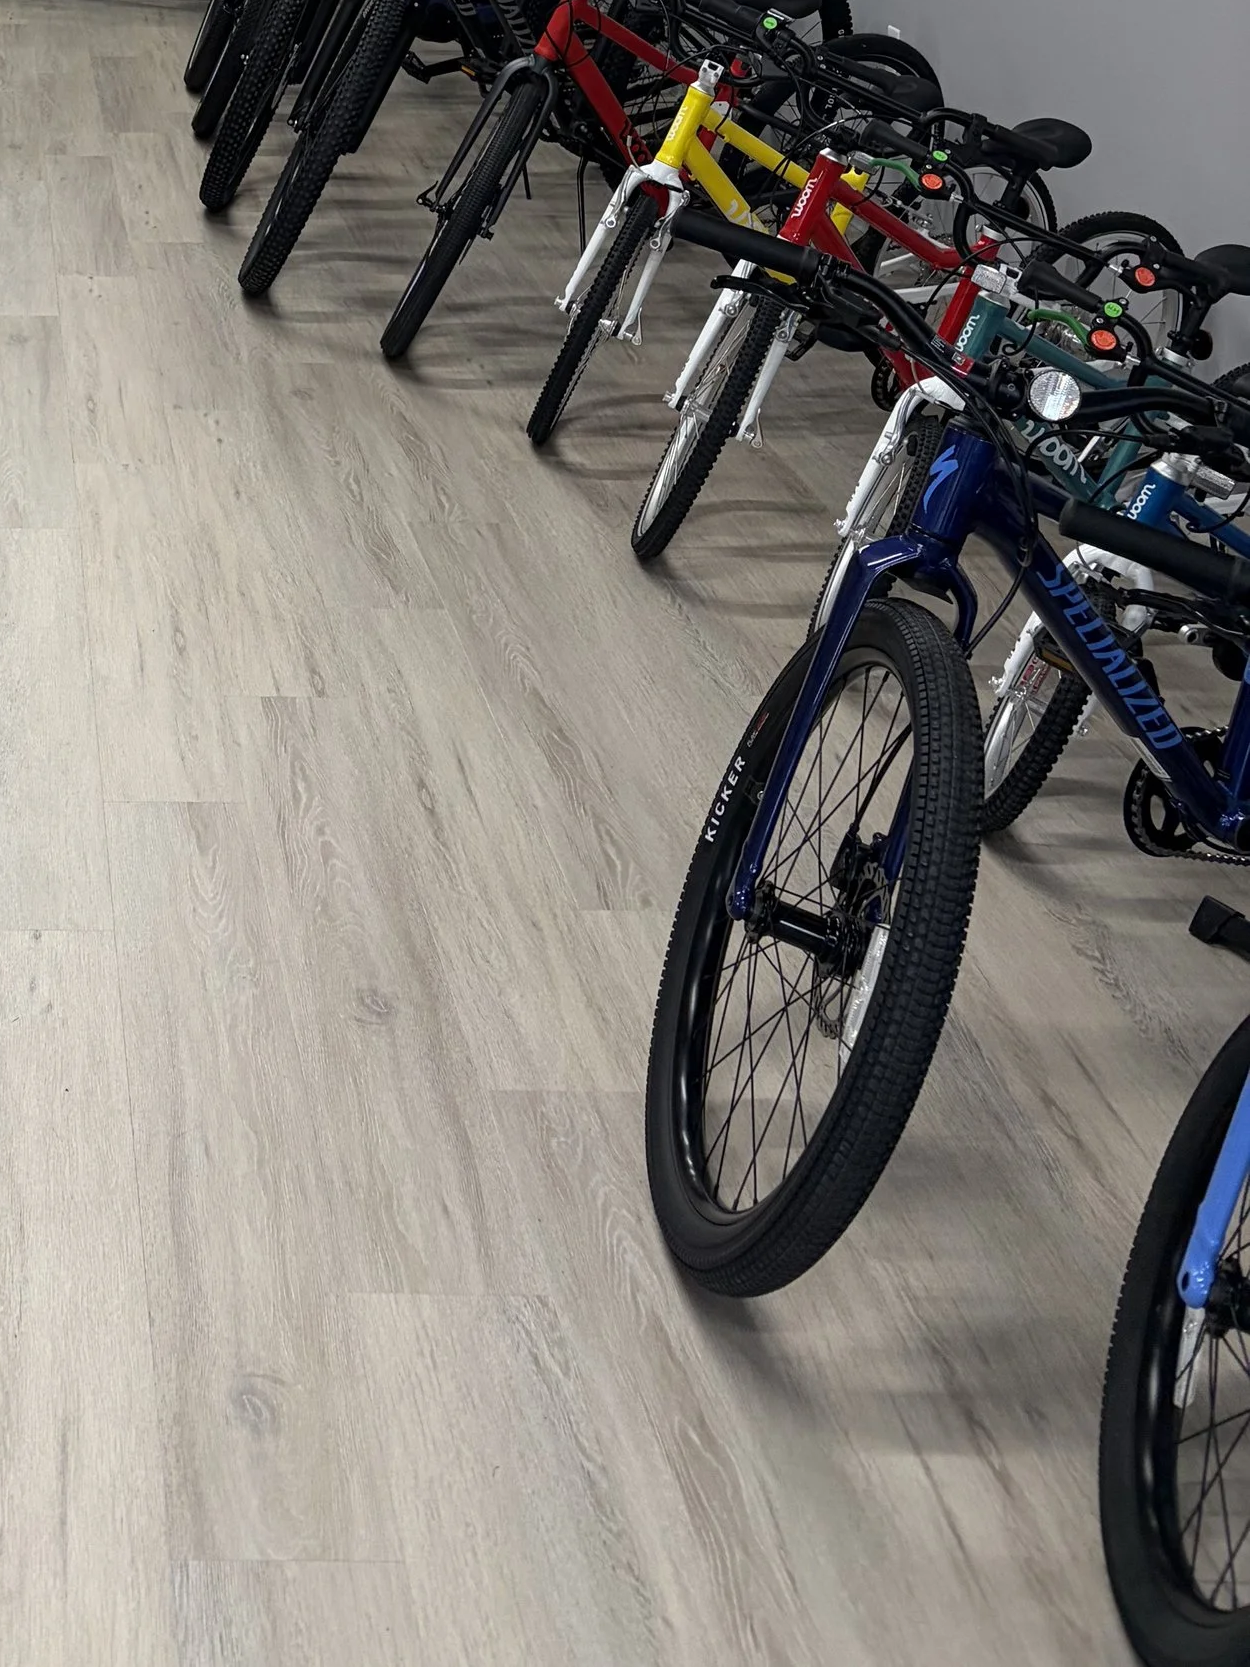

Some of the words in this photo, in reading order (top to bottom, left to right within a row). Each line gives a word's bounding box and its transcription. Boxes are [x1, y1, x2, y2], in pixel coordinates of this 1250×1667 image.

[790, 176, 819, 219] woom
[1036, 562, 1183, 750] SPECIALIZED
[704, 755, 747, 843] KICKER
